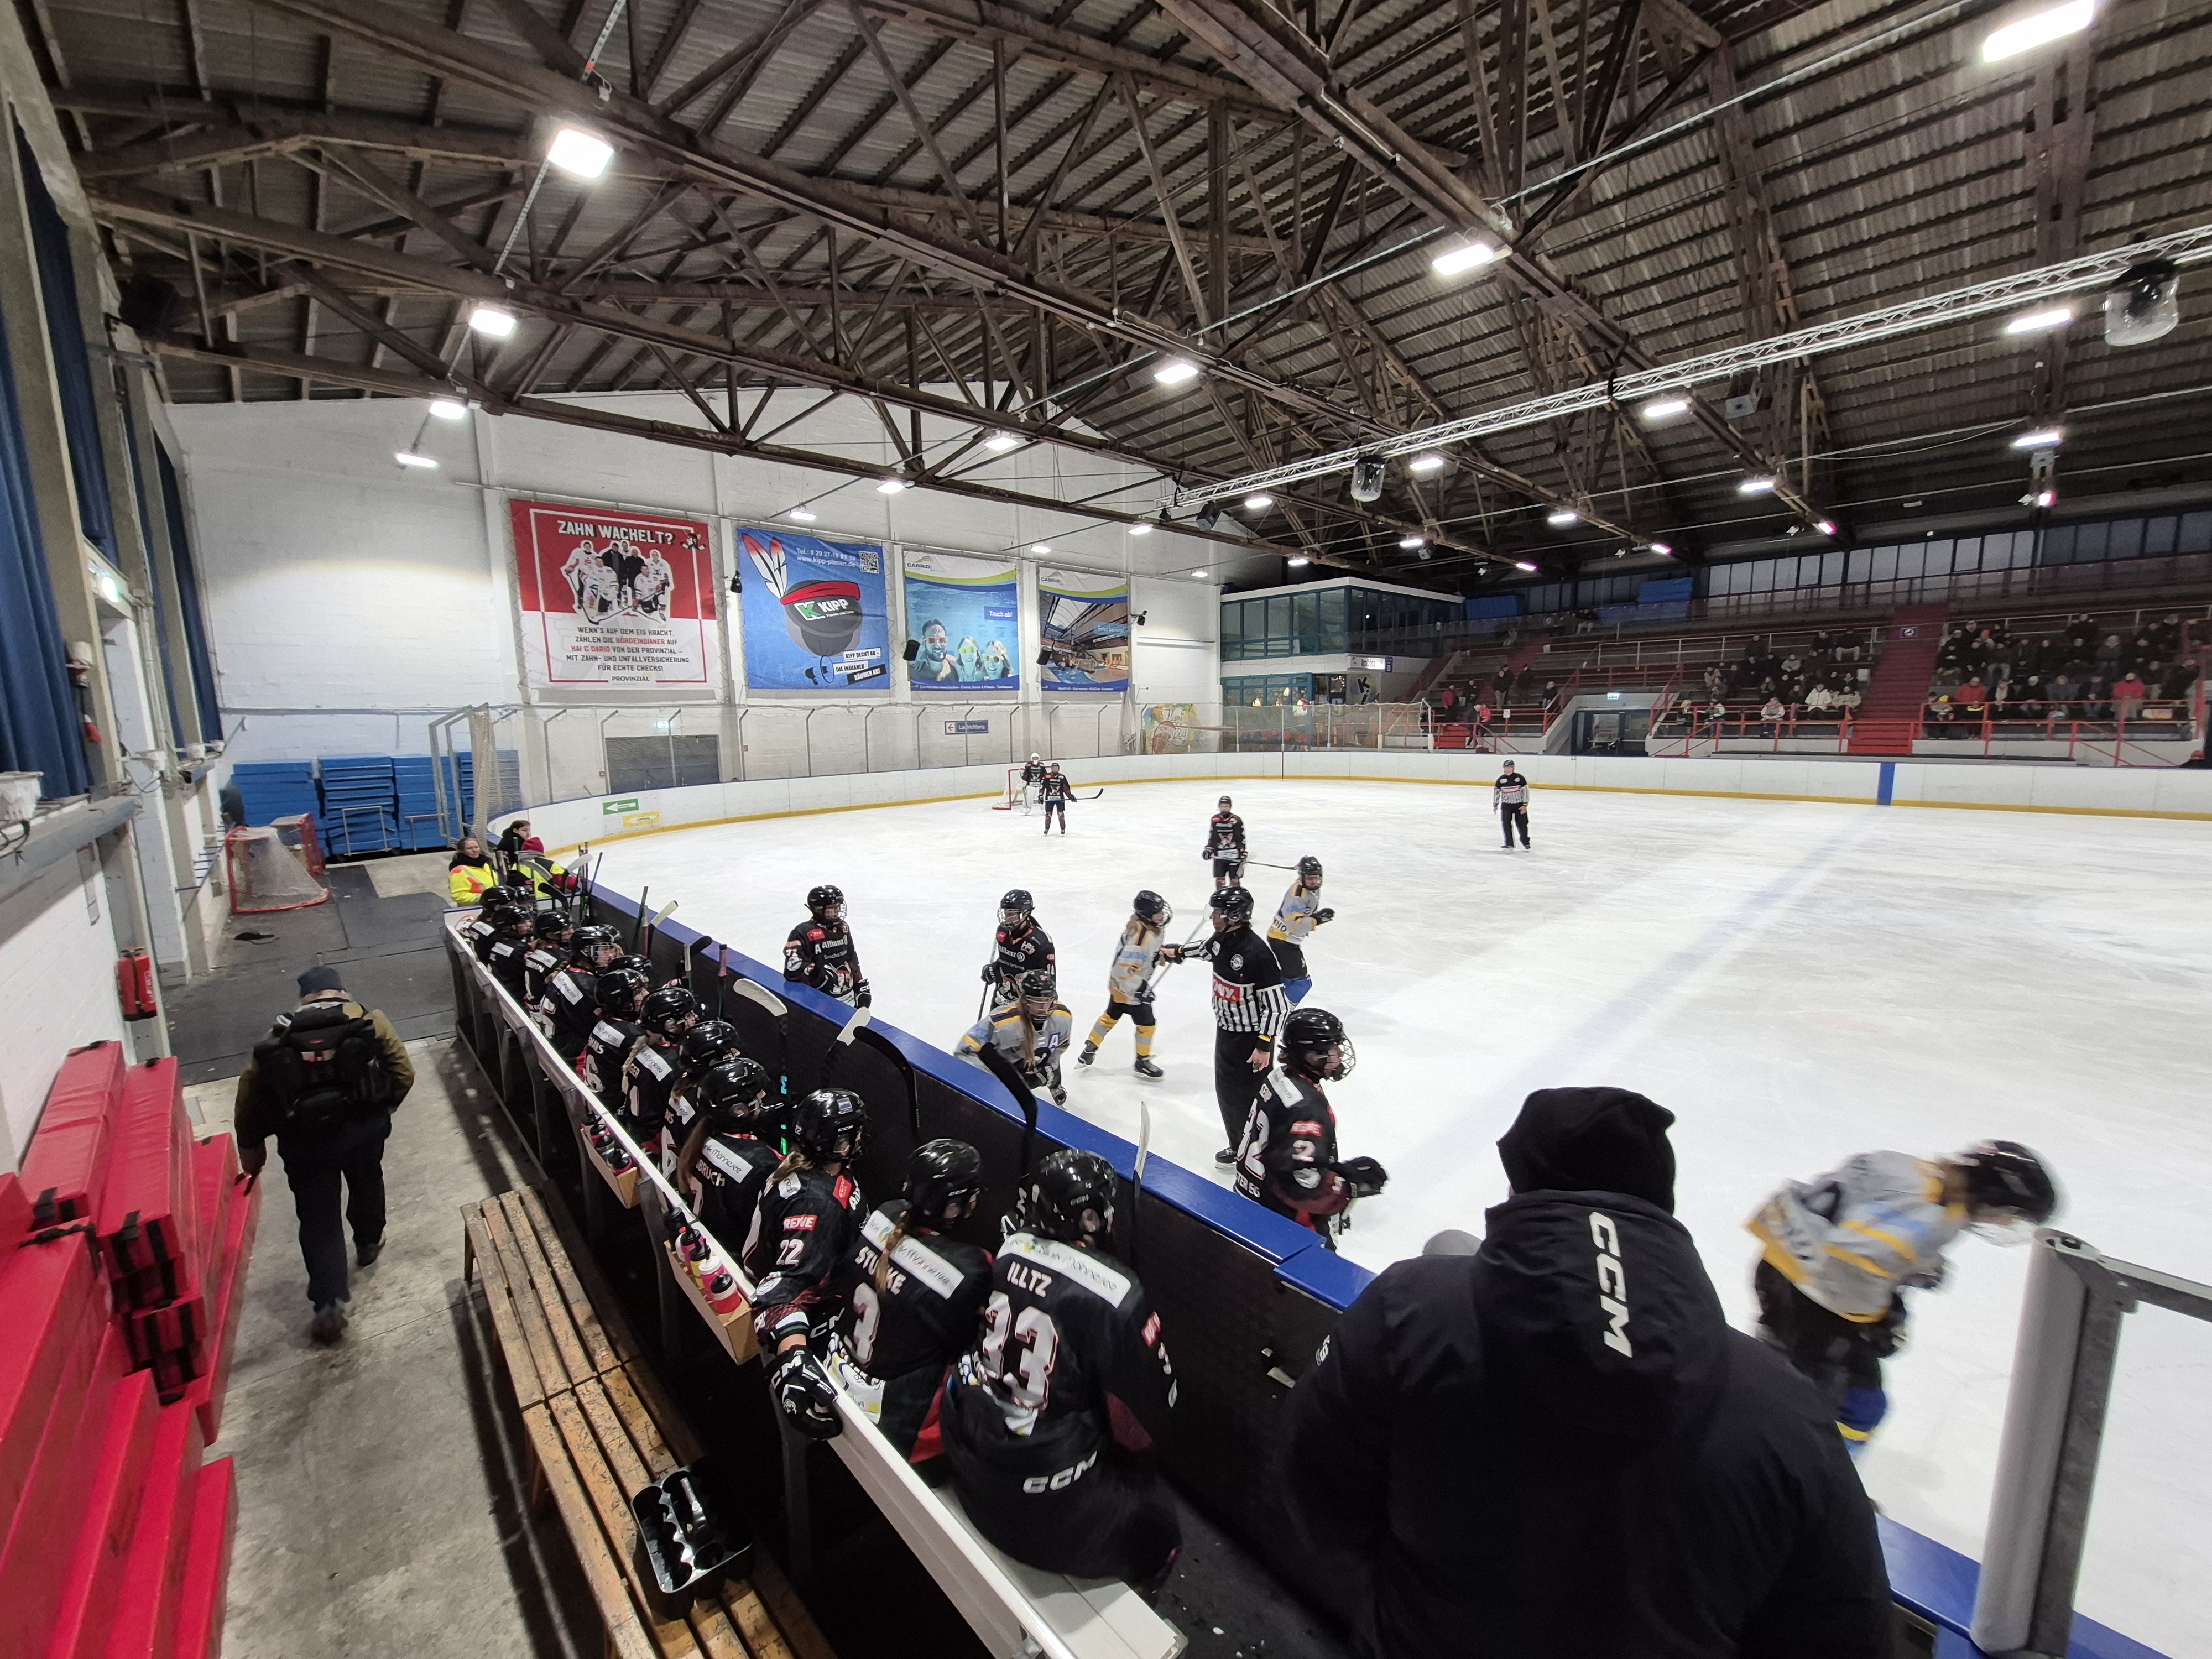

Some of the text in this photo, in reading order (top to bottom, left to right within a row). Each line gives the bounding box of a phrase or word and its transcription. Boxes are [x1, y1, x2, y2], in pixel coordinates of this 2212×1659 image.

[557, 520, 594, 536] ZAHN
[796, 556, 855, 567] www.kipp-planen.de
[817, 599, 849, 613] KIPP
[575, 635, 601, 643] ZÄHLEN
[615, 636, 665, 644] BÖRDEINDIANER
[822, 937, 844, 949] Allianz
[711, 1149, 742, 1174] Möhnesee
[783, 1217, 815, 1230] REWE
[776, 1239, 804, 1266] 22
[1589, 1212, 1632, 1358] CCM
[983, 1290, 1059, 1410] 33
[1022, 1450, 1097, 1494] CCM
